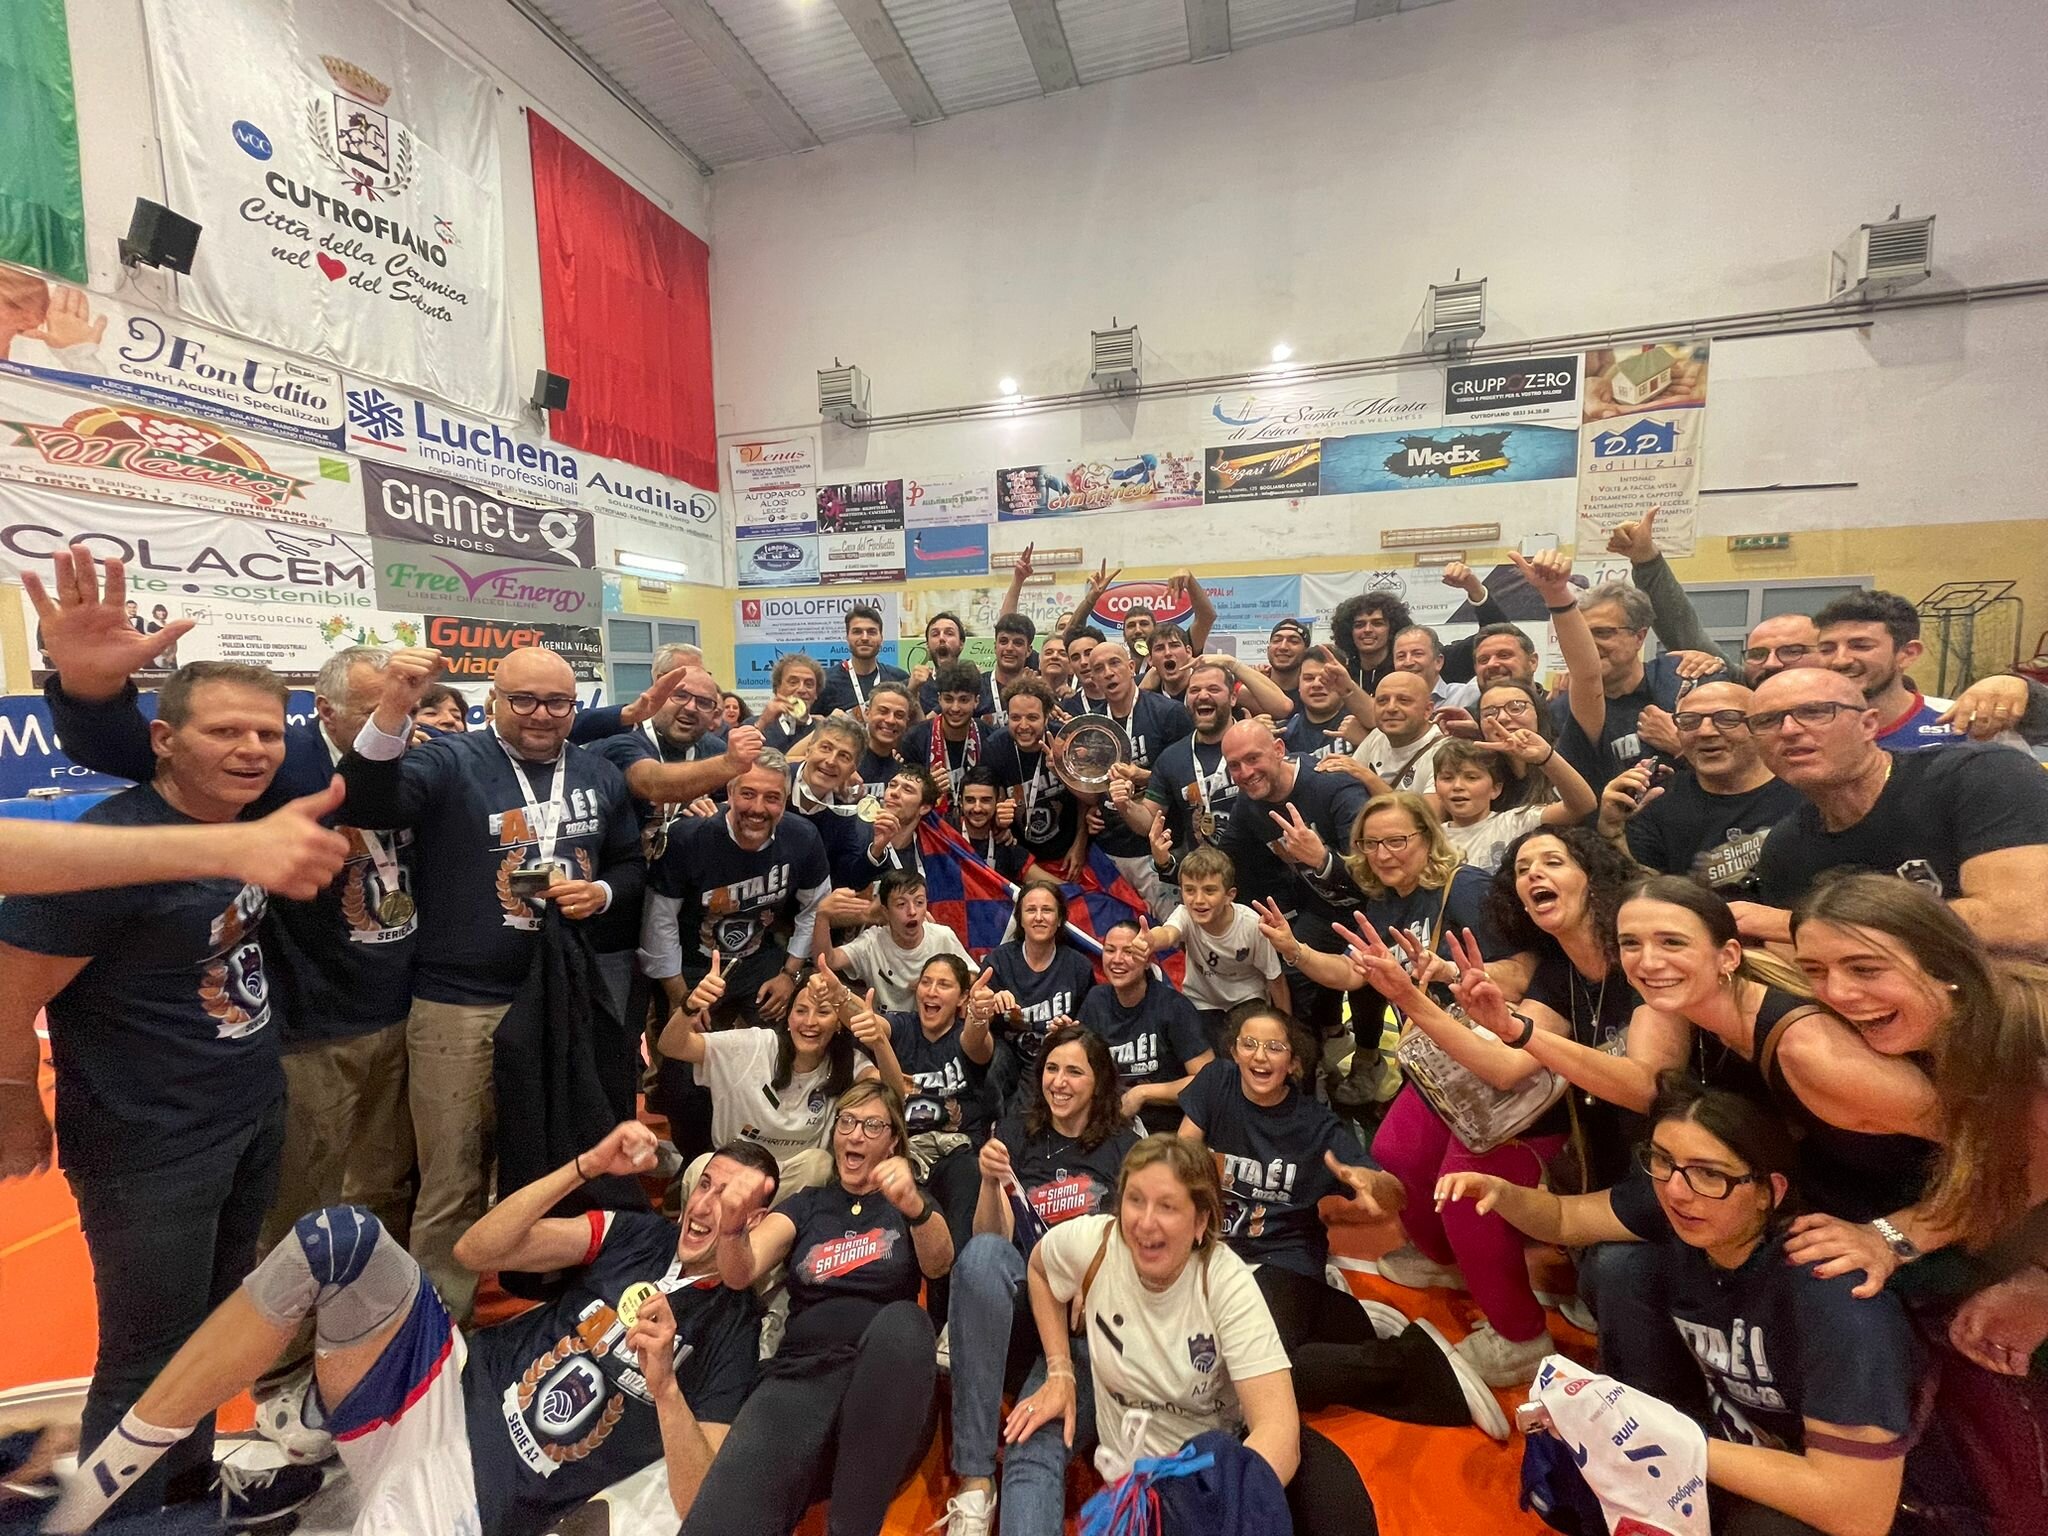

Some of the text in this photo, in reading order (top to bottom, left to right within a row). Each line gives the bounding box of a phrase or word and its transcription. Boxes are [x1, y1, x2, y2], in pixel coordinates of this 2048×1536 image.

[265, 171, 447, 267] CUTROFIANO
[240, 198, 469, 305] Città della Ceramica
[272, 244, 310, 269] nel
[349, 271, 382, 294] del
[119, 363, 330, 426] Centri Acustici Specializzati
[1282, 405, 1340, 424] Santa
[414, 400, 579, 481] Luchena
[740, 446, 805, 462] Venus
[1408, 444, 1480, 467] MedEx
[1590, 455, 1693, 472] edilizia
[41, 431, 290, 506] Mauro
[420, 442, 579, 496] impianti professionali
[1210, 460, 1267, 481] Lazzari
[19, 465, 86, 482] Cesare
[230, 501, 308, 519] CUTROFIANO
[586, 472, 706, 519] Audilab
[745, 490, 806, 501] AUTOPARCO
[1591, 494, 1637, 502] ISOLAMENTO
[1584, 502, 1633, 510] TRATTAMENTO
[433, 534, 495, 554] SHOES
[0, 524, 366, 590] COLACEM
[213, 582, 372, 608] sostenibile
[386, 563, 585, 613] Free Energy
[1108, 596, 1176, 612] COPRAL
[225, 612, 313, 624] OUTSOURCING
[538, 640, 573, 651] AGENZIA
[737, 677, 770, 686] Autonole
[1207, 951, 1219, 967] 8
[1047, 1183, 1079, 1201] SIAMO
[834, 1237, 869, 1254] SIAMO
[815, 1242, 877, 1274] SATURNIA
[508, 1412, 540, 1463] SERIE A2
[1612, 1416, 1640, 1447] nine
[1667, 1475, 1704, 1512] fieldgood
